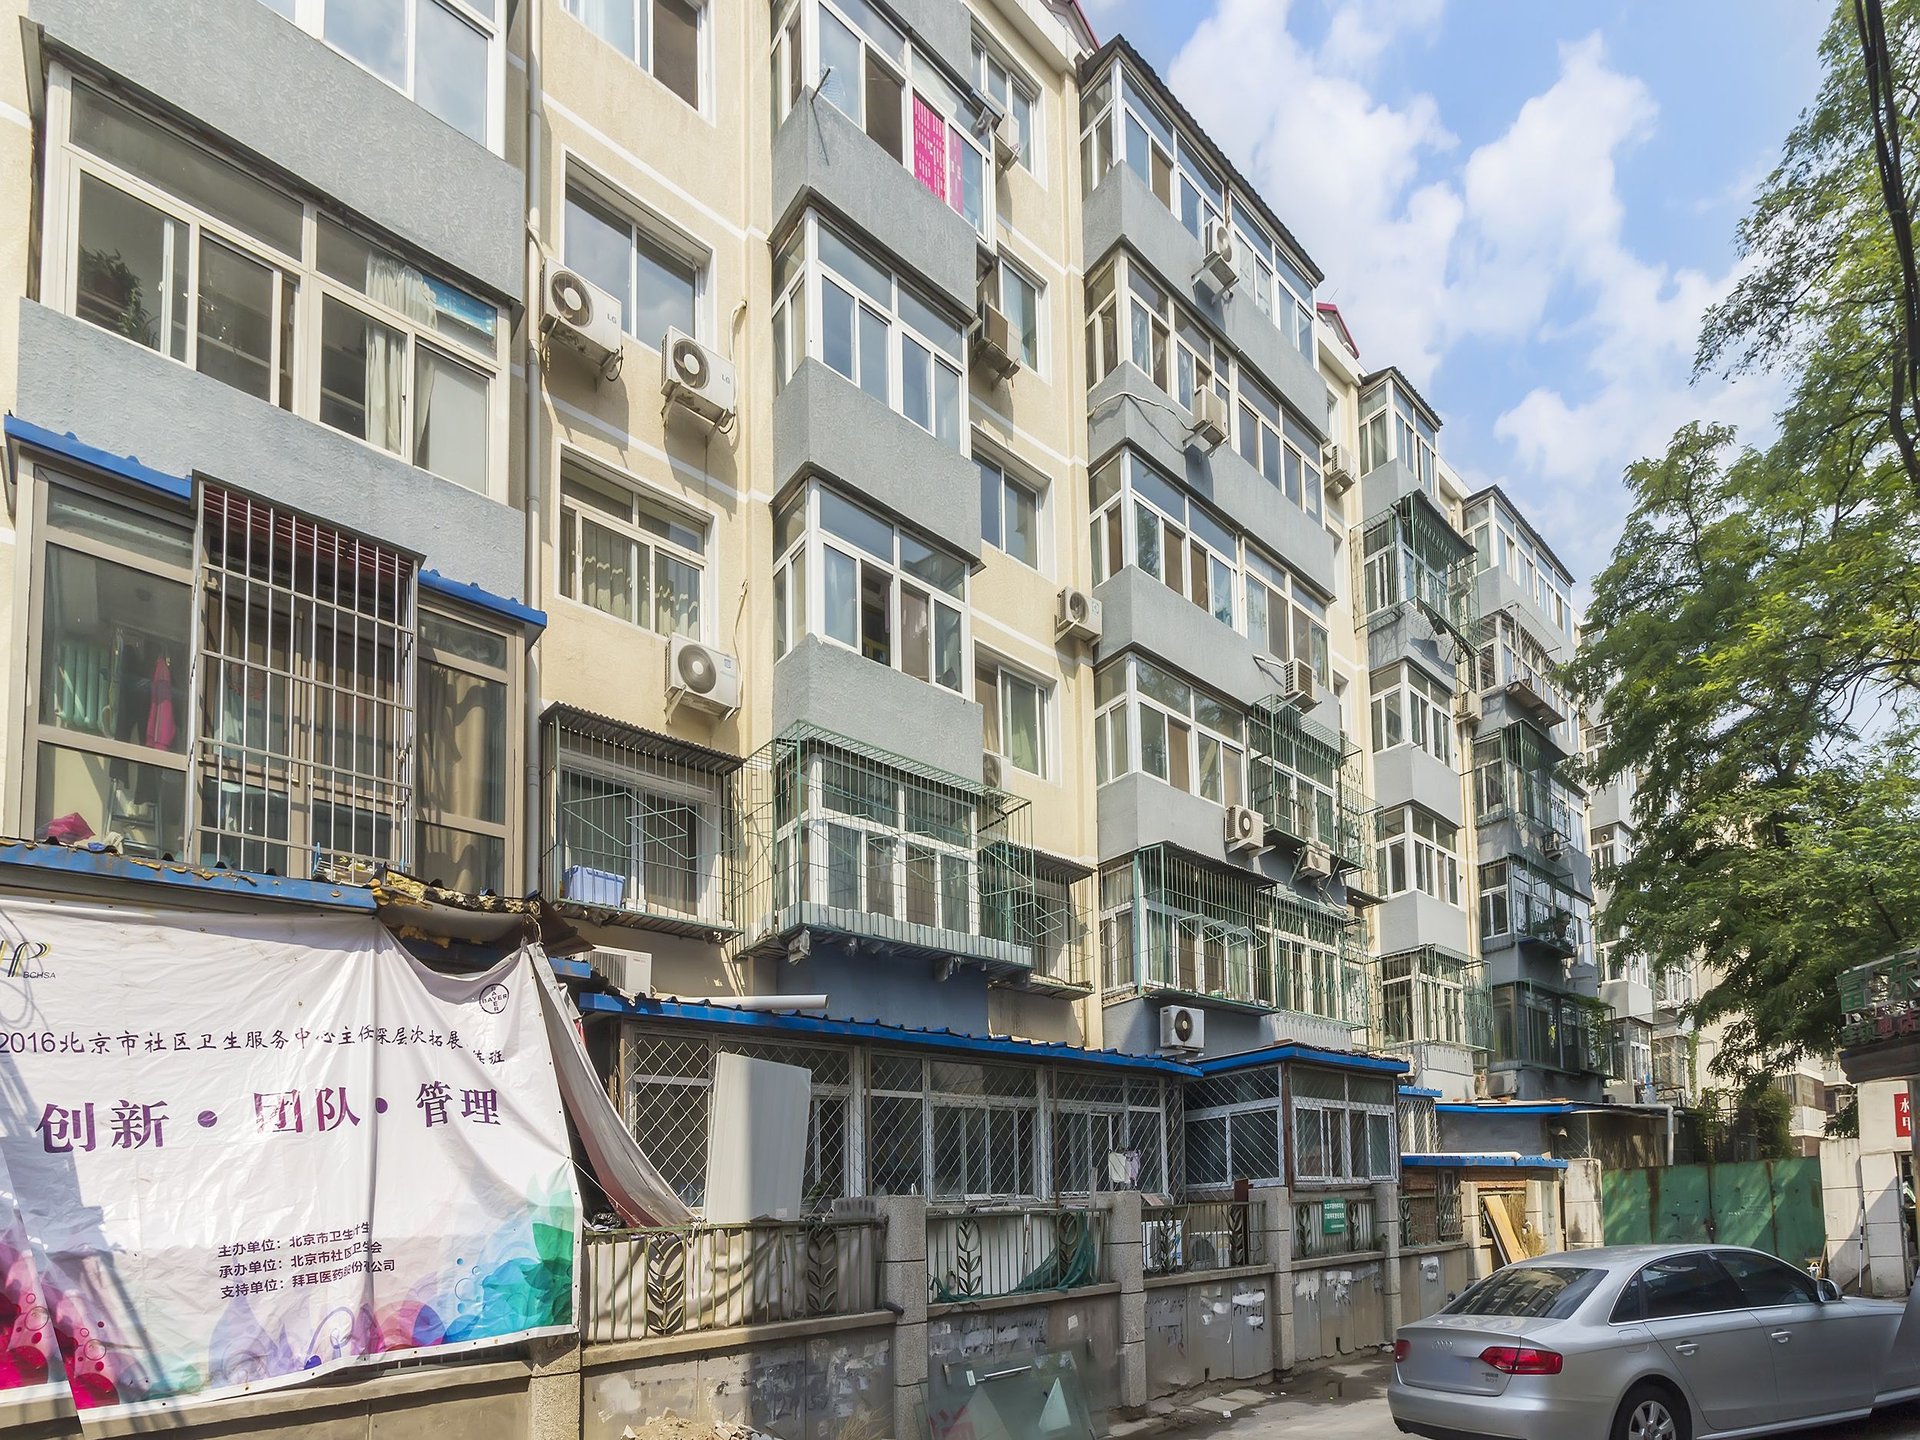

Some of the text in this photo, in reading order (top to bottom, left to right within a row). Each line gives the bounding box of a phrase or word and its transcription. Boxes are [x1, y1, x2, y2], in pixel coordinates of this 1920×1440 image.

[607, 312, 617, 325] LG
[721, 373, 731, 385] LG
[22, 971, 56, 979] BCHSA
